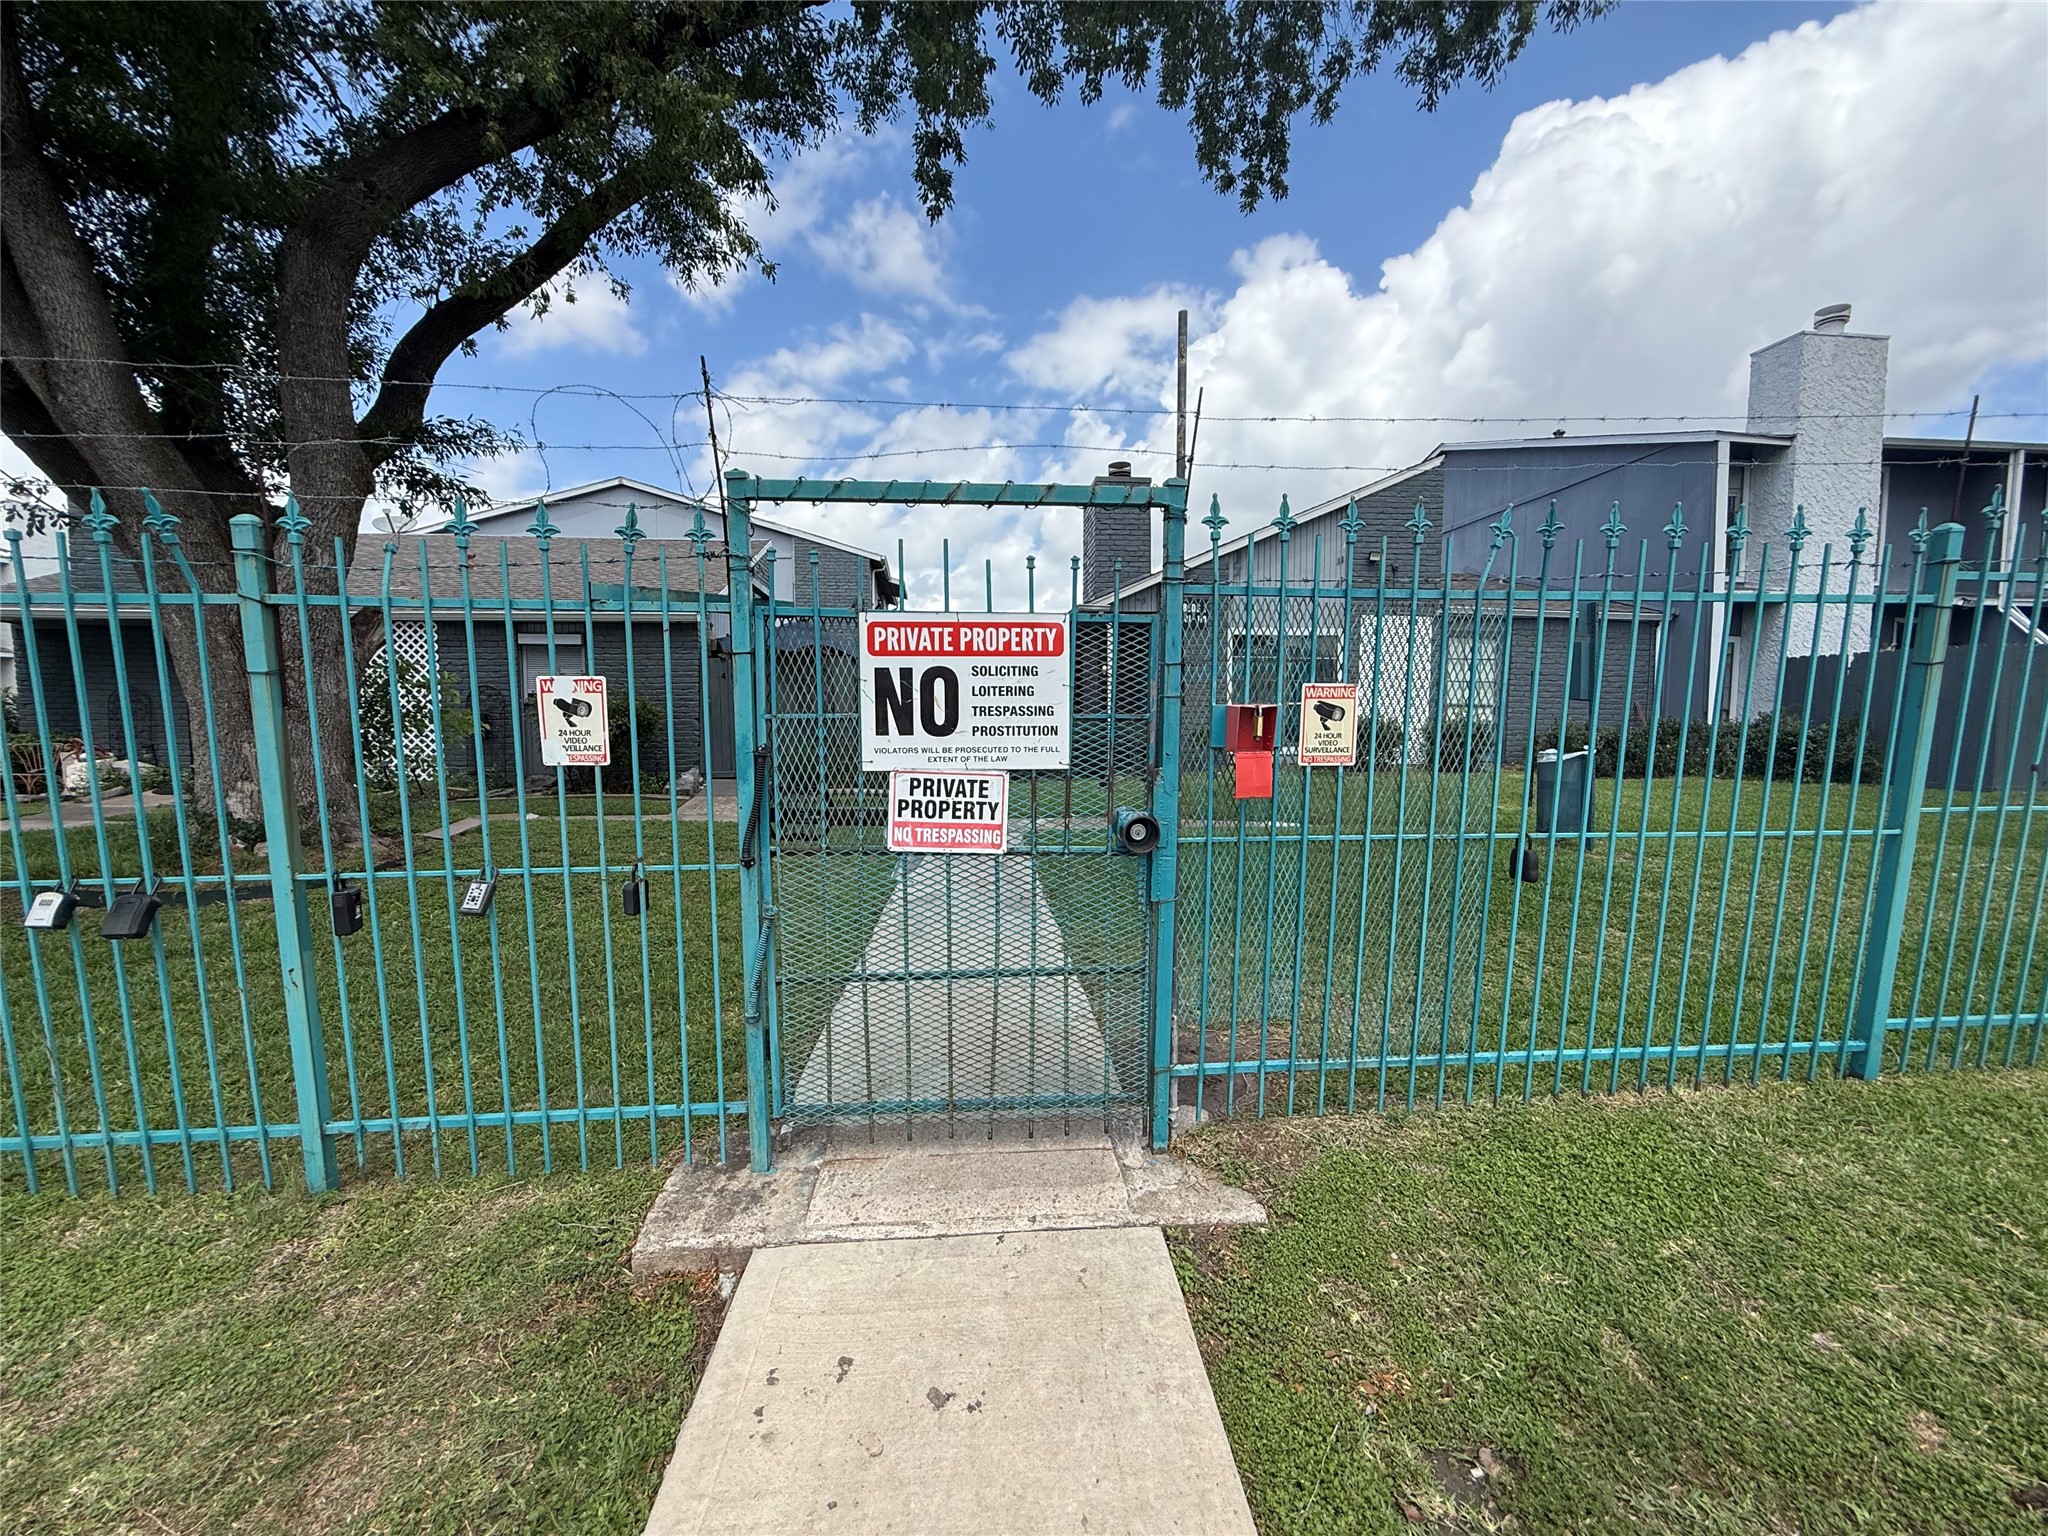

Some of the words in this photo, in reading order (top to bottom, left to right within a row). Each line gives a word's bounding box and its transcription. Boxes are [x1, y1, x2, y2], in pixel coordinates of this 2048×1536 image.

[874, 627, 954, 652] PRIVATE
[960, 627, 1057, 652] PROPERTY
[971, 665, 1039, 677] SOLICITING
[541, 680, 603, 692] WNING
[971, 685, 1035, 697] LOITERING
[1305, 687, 1355, 698] WARNING
[874, 665, 960, 737] NO
[971, 705, 1055, 717] TRESPASSING
[972, 725, 1059, 737] PROSTITUTION
[874, 747, 919, 755] VIOLATORS
[921, 747, 940, 755] WILL
[1010, 746, 1021, 754] TO
[1023, 746, 1039, 754] THE
[1040, 746, 1060, 754] FULL
[569, 754, 605, 762] ESPASSING
[927, 755, 958, 763] EXTENT
[960, 755, 972, 763] OF
[973, 755, 989, 763] THE
[990, 755, 1008, 763] LAW
[1303, 755, 1313, 763] NO
[1313, 755, 1351, 763] TRESPASSING
[909, 777, 990, 799] PRIVATE
[897, 798, 1000, 821] PROPERTY
[894, 826, 912, 843] NO
[915, 827, 1001, 845] TRESPASSING
